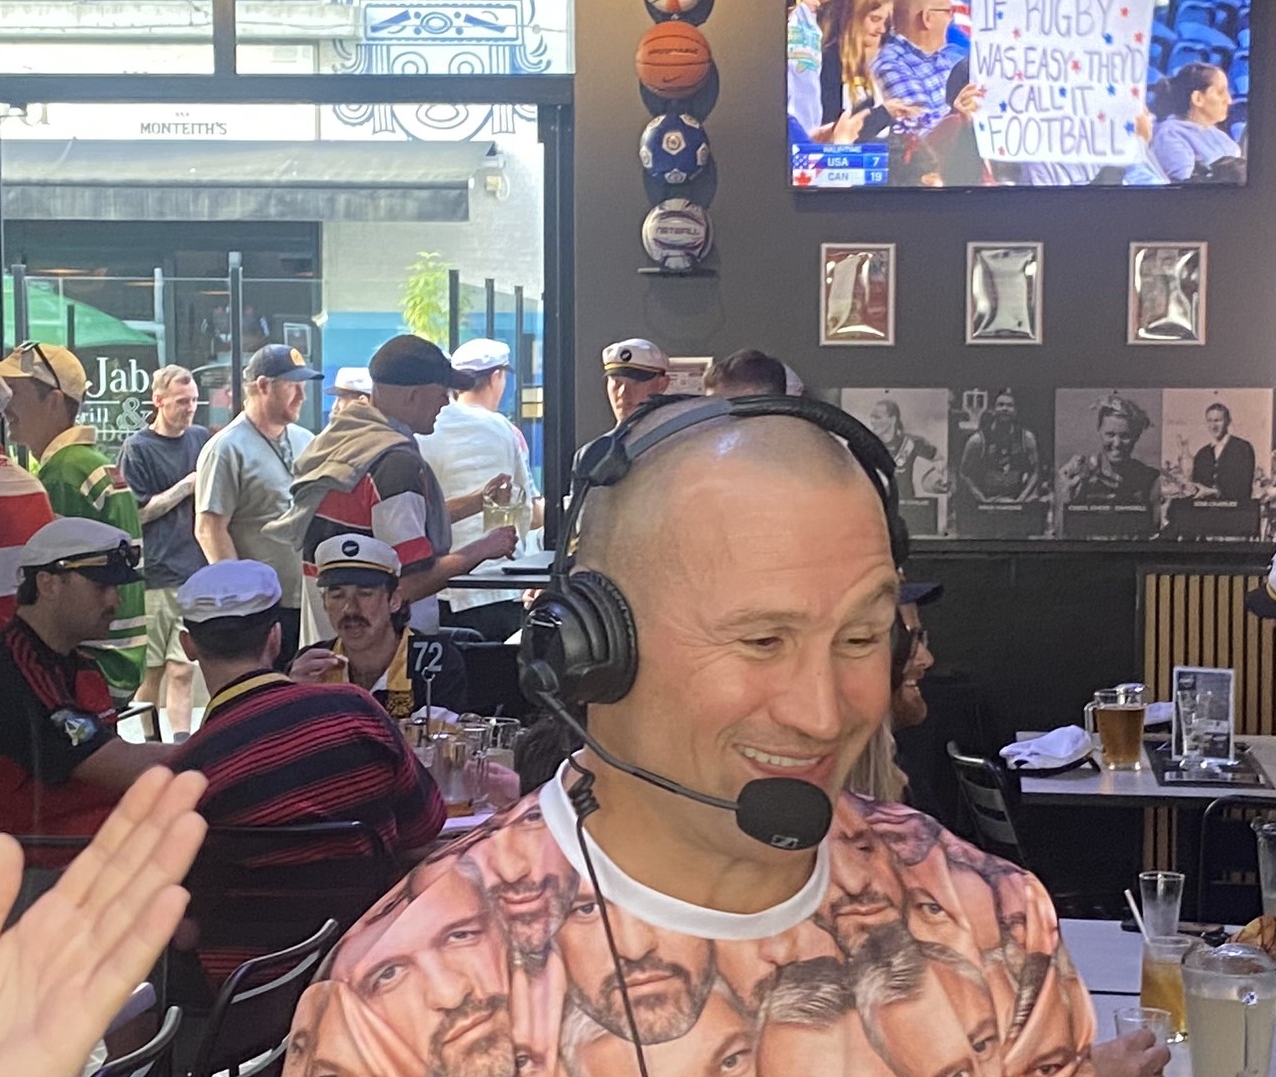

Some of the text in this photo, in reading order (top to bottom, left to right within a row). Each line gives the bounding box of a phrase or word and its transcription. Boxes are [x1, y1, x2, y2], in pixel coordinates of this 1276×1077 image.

[975, 41, 1017, 81] WAS
[1023, 46, 1072, 83] EASY
[1008, 84, 1094, 116] CALL IT
[139, 121, 227, 135] MONTEITH'S
[988, 115, 1125, 157] FOOTBALL
[827, 156, 880, 167] USA 7
[827, 172, 883, 182] CAN 19
[85, 356, 150, 398] Jab
[412, 641, 443, 672] 72
